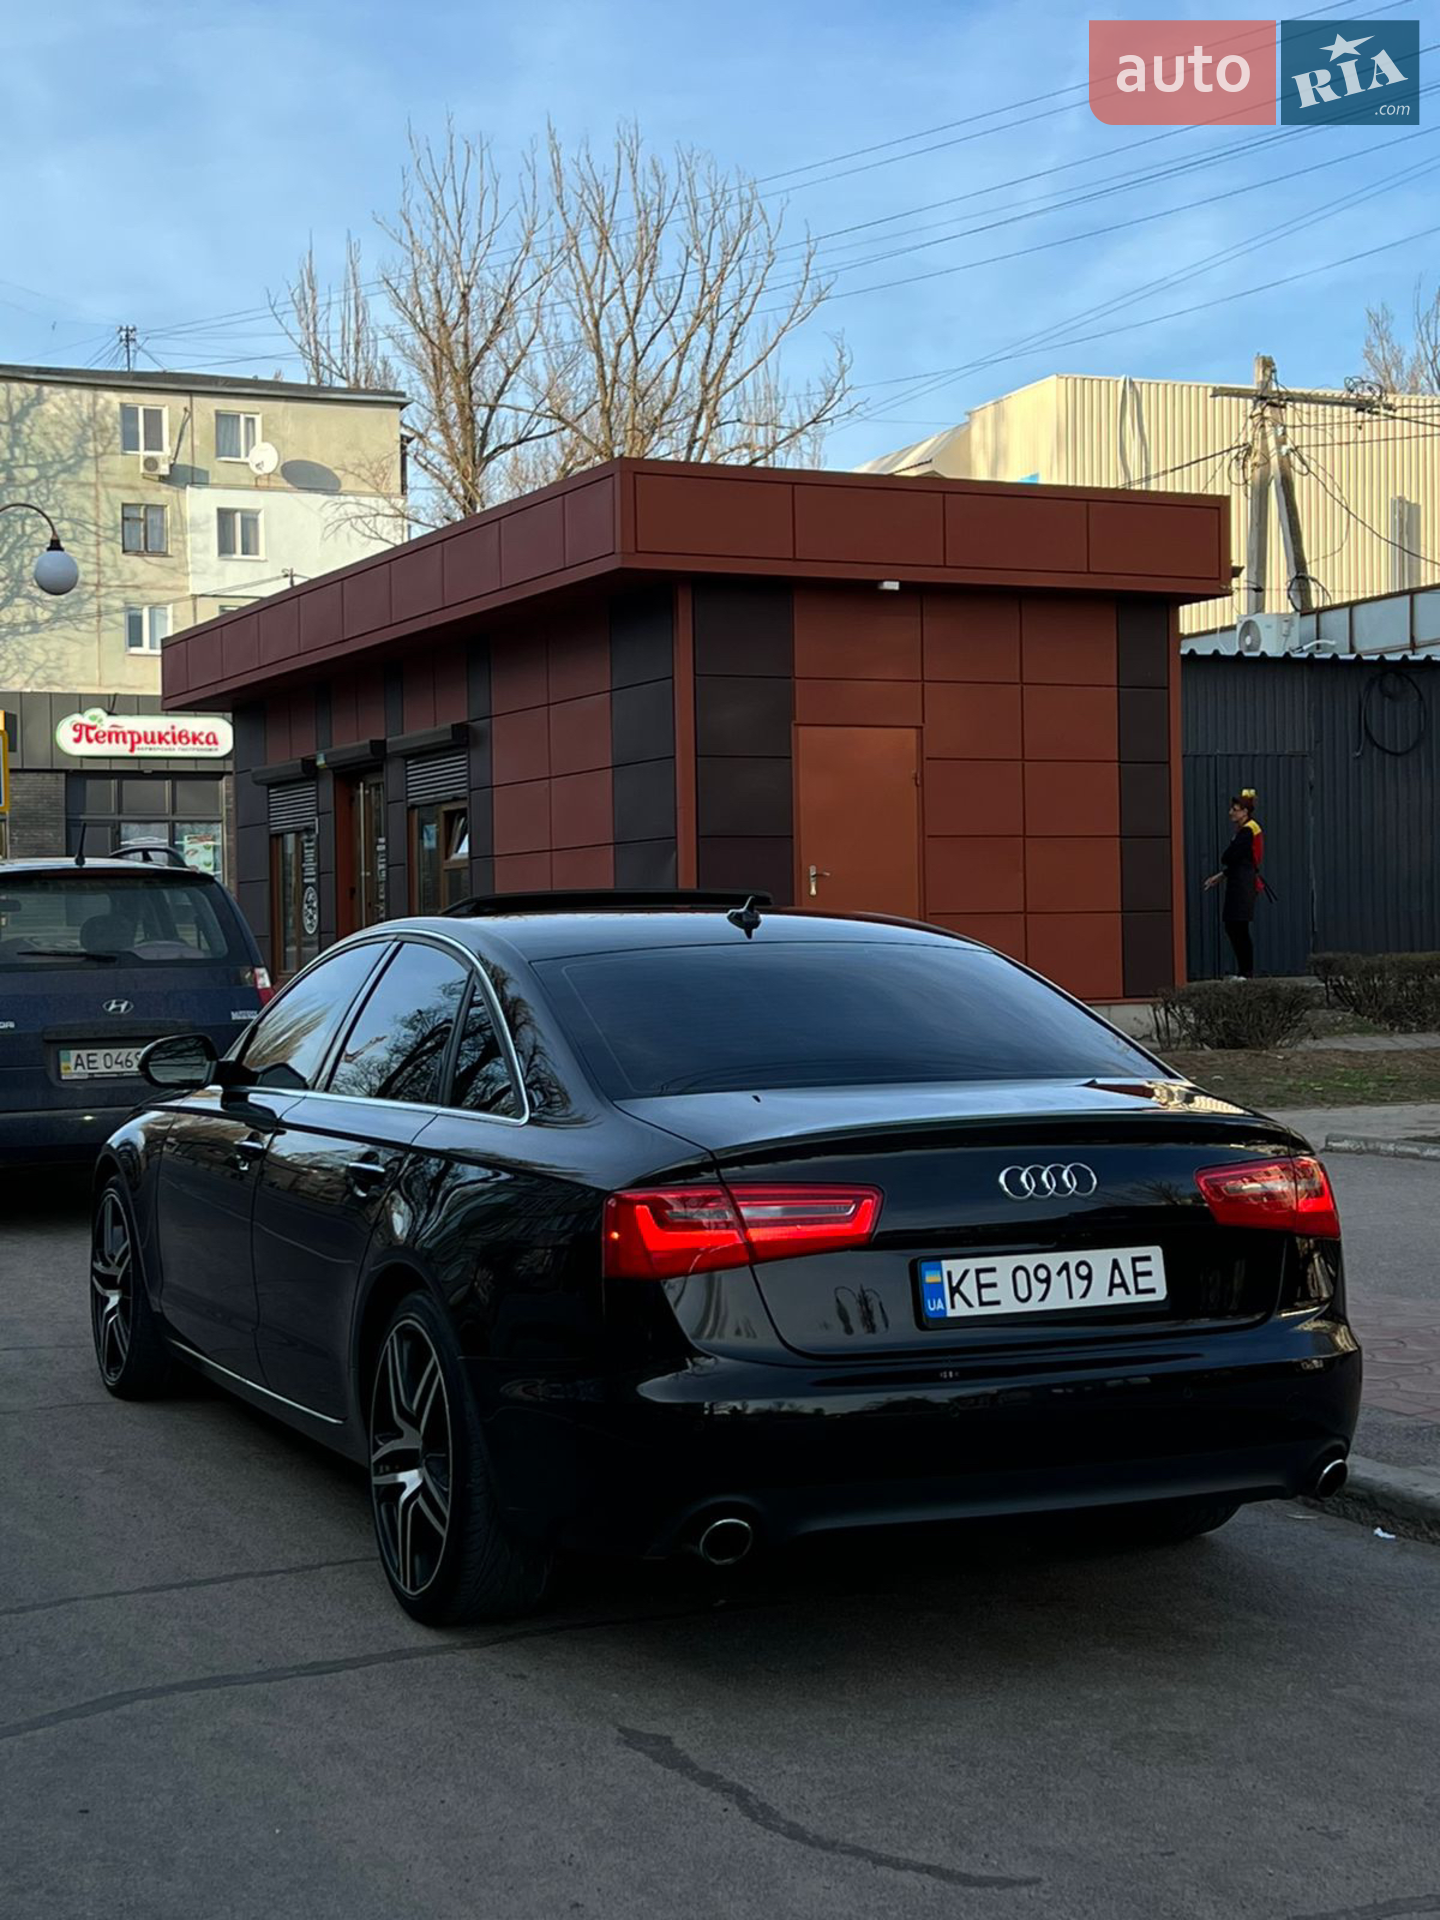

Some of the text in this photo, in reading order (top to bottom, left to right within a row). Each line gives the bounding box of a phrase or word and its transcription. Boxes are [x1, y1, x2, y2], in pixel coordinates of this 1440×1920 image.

[72, 722, 219, 753] Петриківка
[74, 1053, 99, 1071] AE
[946, 1255, 1156, 1309] KE 0919 AE
[928, 1299, 945, 1311] UA
